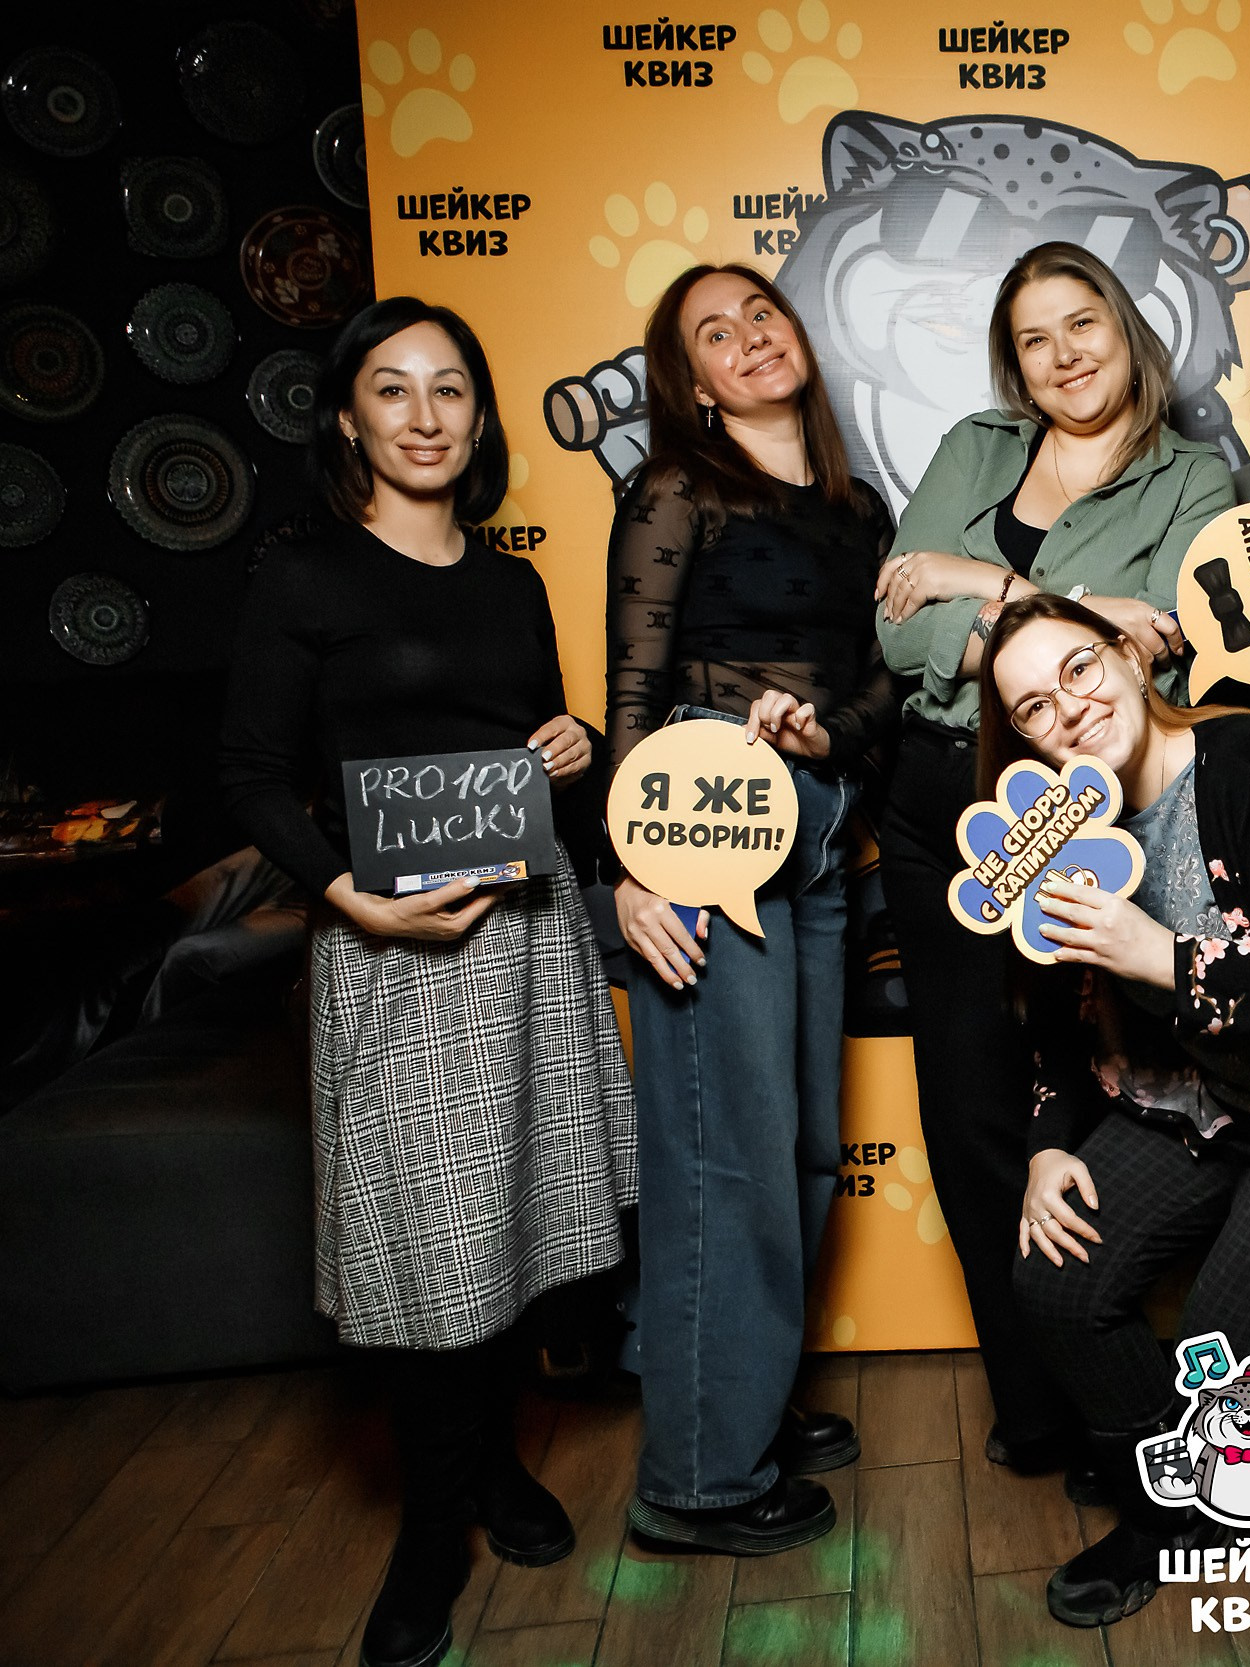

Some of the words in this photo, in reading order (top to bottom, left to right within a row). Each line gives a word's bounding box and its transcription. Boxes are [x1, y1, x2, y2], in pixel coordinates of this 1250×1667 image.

[602, 17, 736, 52] ШЕЙКЕР
[939, 20, 1070, 54] ШЕЙКЕР
[624, 60, 713, 88] КВИЗ
[959, 64, 1046, 90] КВИЗ
[397, 186, 531, 221] ШЕЙКЕР
[733, 186, 826, 219] ШЕЙК
[419, 230, 508, 257] КВИЗ
[754, 229, 800, 255] КВ
[640, 772, 670, 811] Я
[692, 775, 771, 815] ЖЕ
[626, 820, 785, 851] ГОВОРИЛ!
[973, 850, 1007, 888] НЕ
[1003, 785, 1070, 855] СПОРЬ
[980, 901, 999, 922] С
[992, 785, 1105, 908] КАПИТАНОМ
[841, 1143, 896, 1166] КЕР
[836, 1174, 875, 1197] ИЗ
